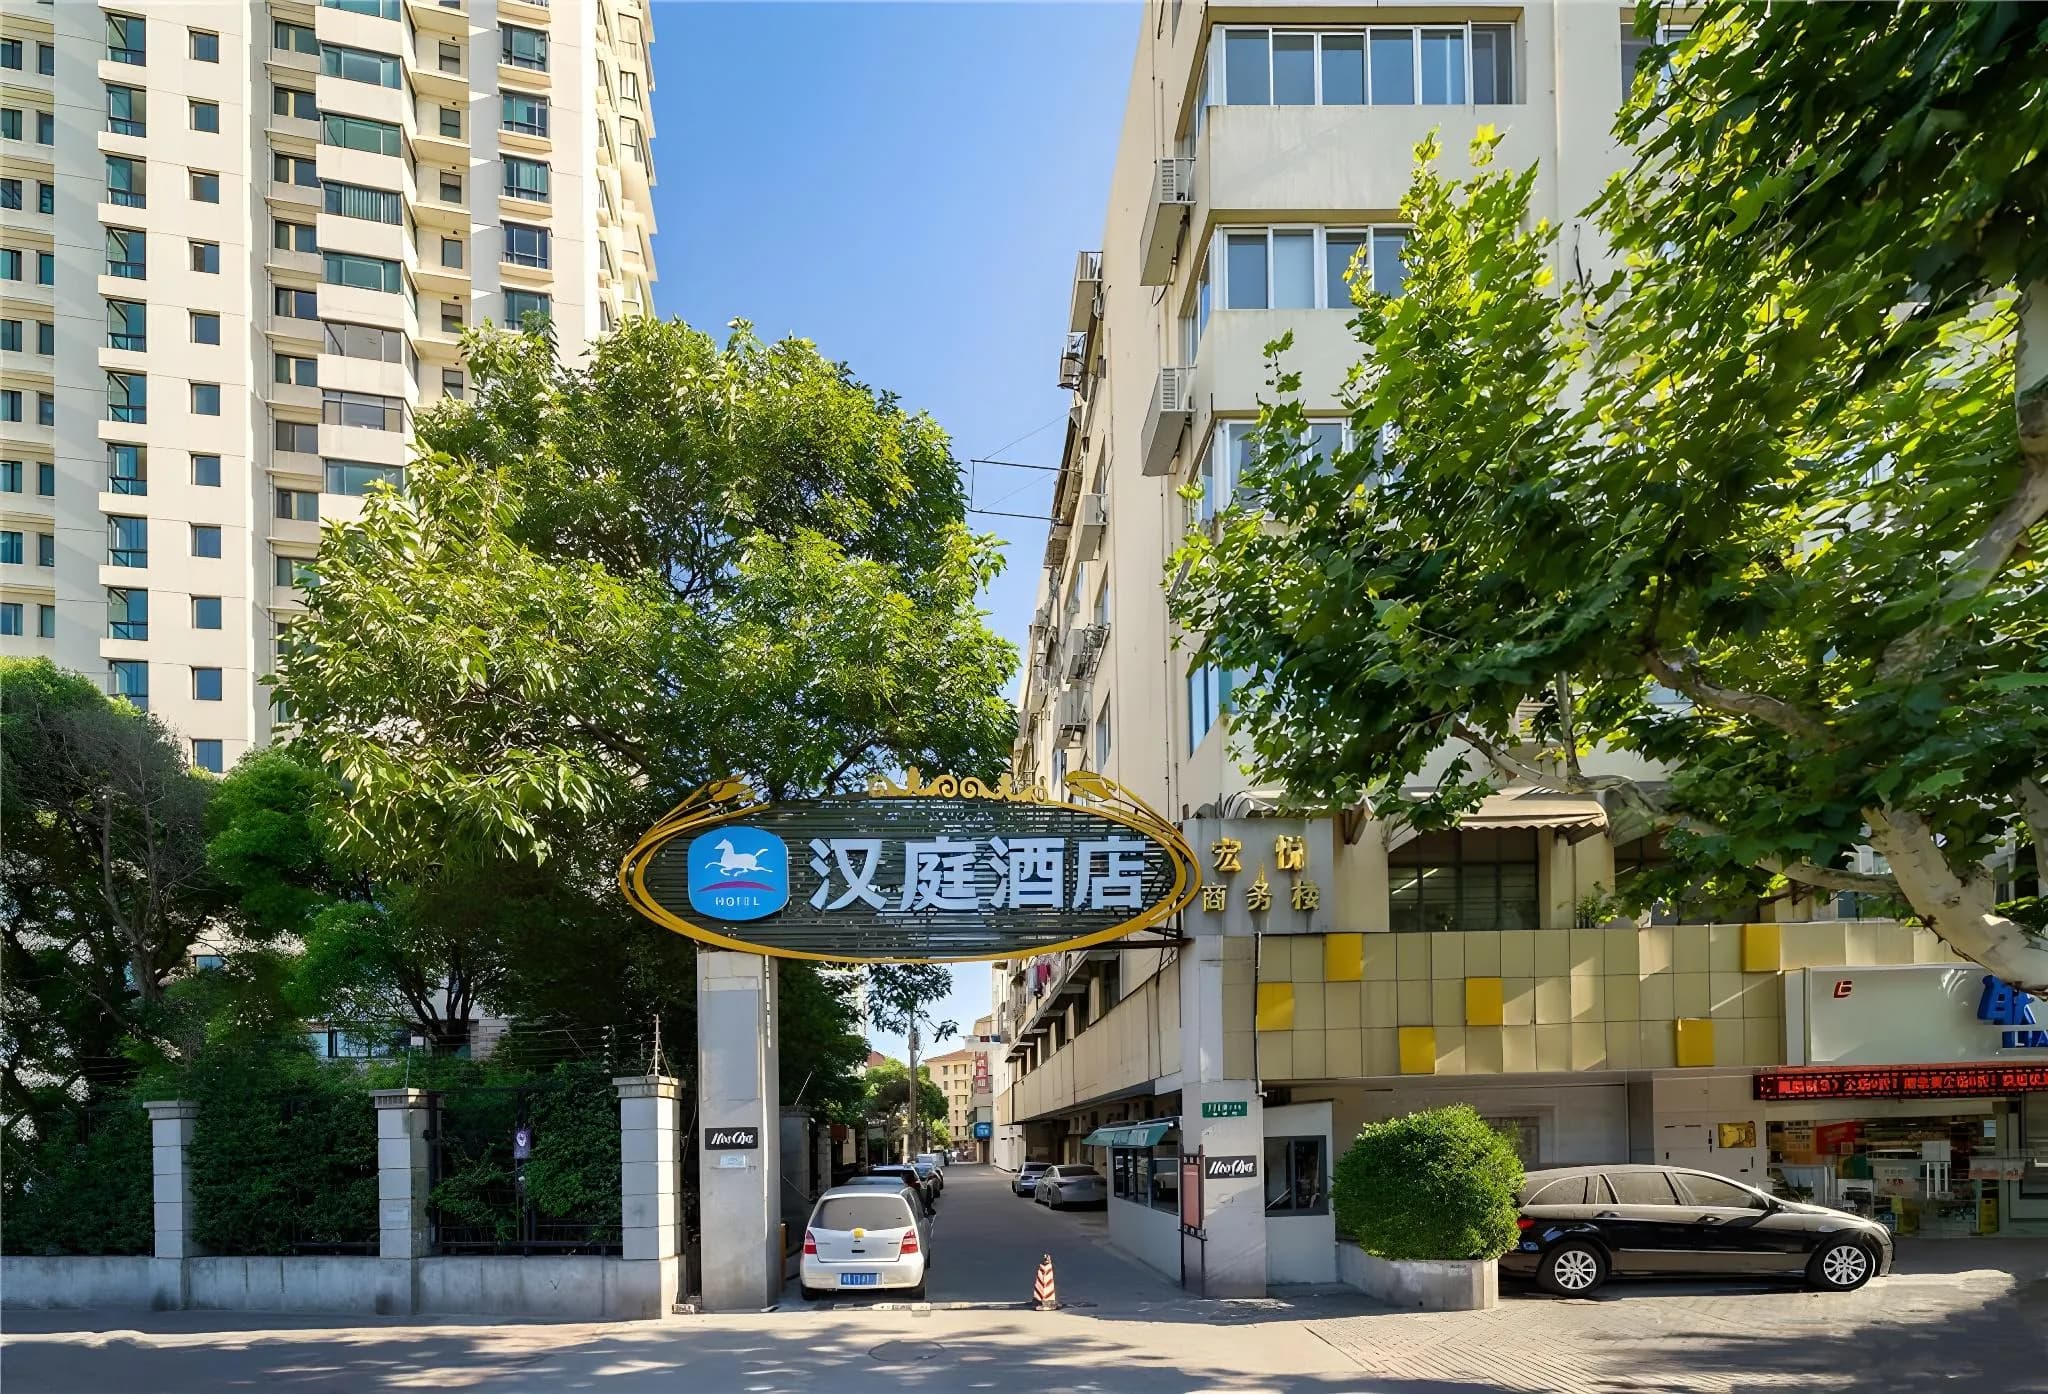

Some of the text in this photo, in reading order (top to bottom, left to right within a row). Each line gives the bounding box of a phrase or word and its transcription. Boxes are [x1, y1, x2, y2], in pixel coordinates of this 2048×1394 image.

[808, 835, 1147, 912] 汉庭酒店
[1201, 880, 1321, 912] 商务楼
